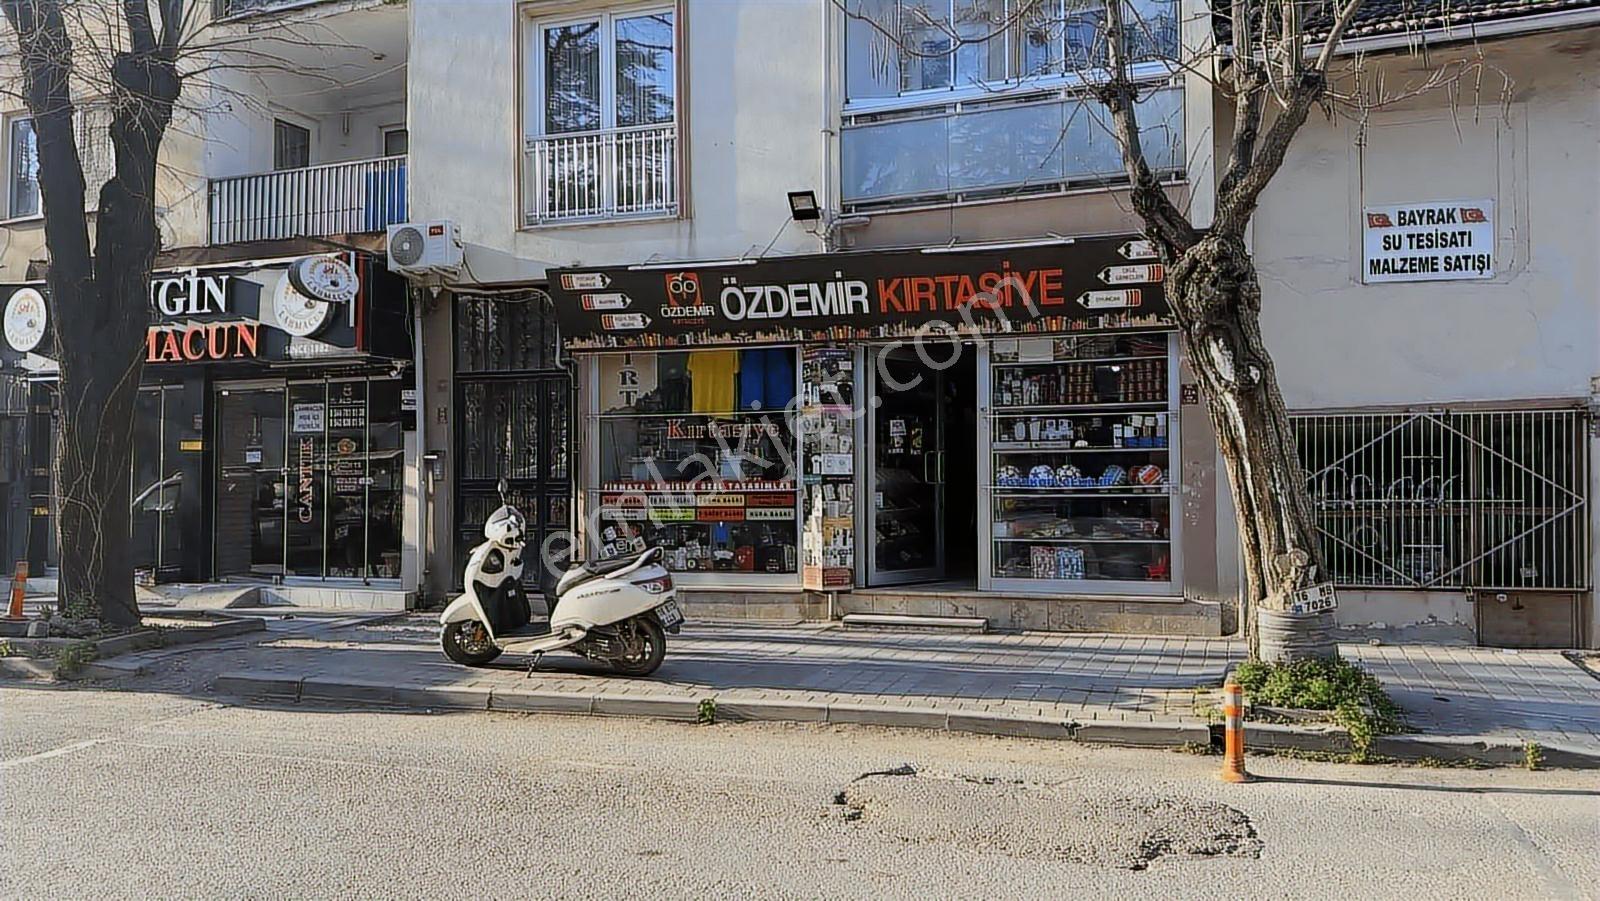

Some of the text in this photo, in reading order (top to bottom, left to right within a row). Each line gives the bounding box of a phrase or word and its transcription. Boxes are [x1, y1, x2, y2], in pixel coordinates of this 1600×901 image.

[1397, 207, 1457, 227] BAYRAK
[1383, 228, 1472, 251] SU TESİSATI
[1369, 253, 1491, 275] MALZEME SATIŞI
[720, 260, 1065, 321] ÖZDEMİR KIRTASİYE
[661, 302, 715, 317] ÖZDEMİR
[1295, 591, 1309, 602] 16
[1305, 597, 1331, 611] 7026
